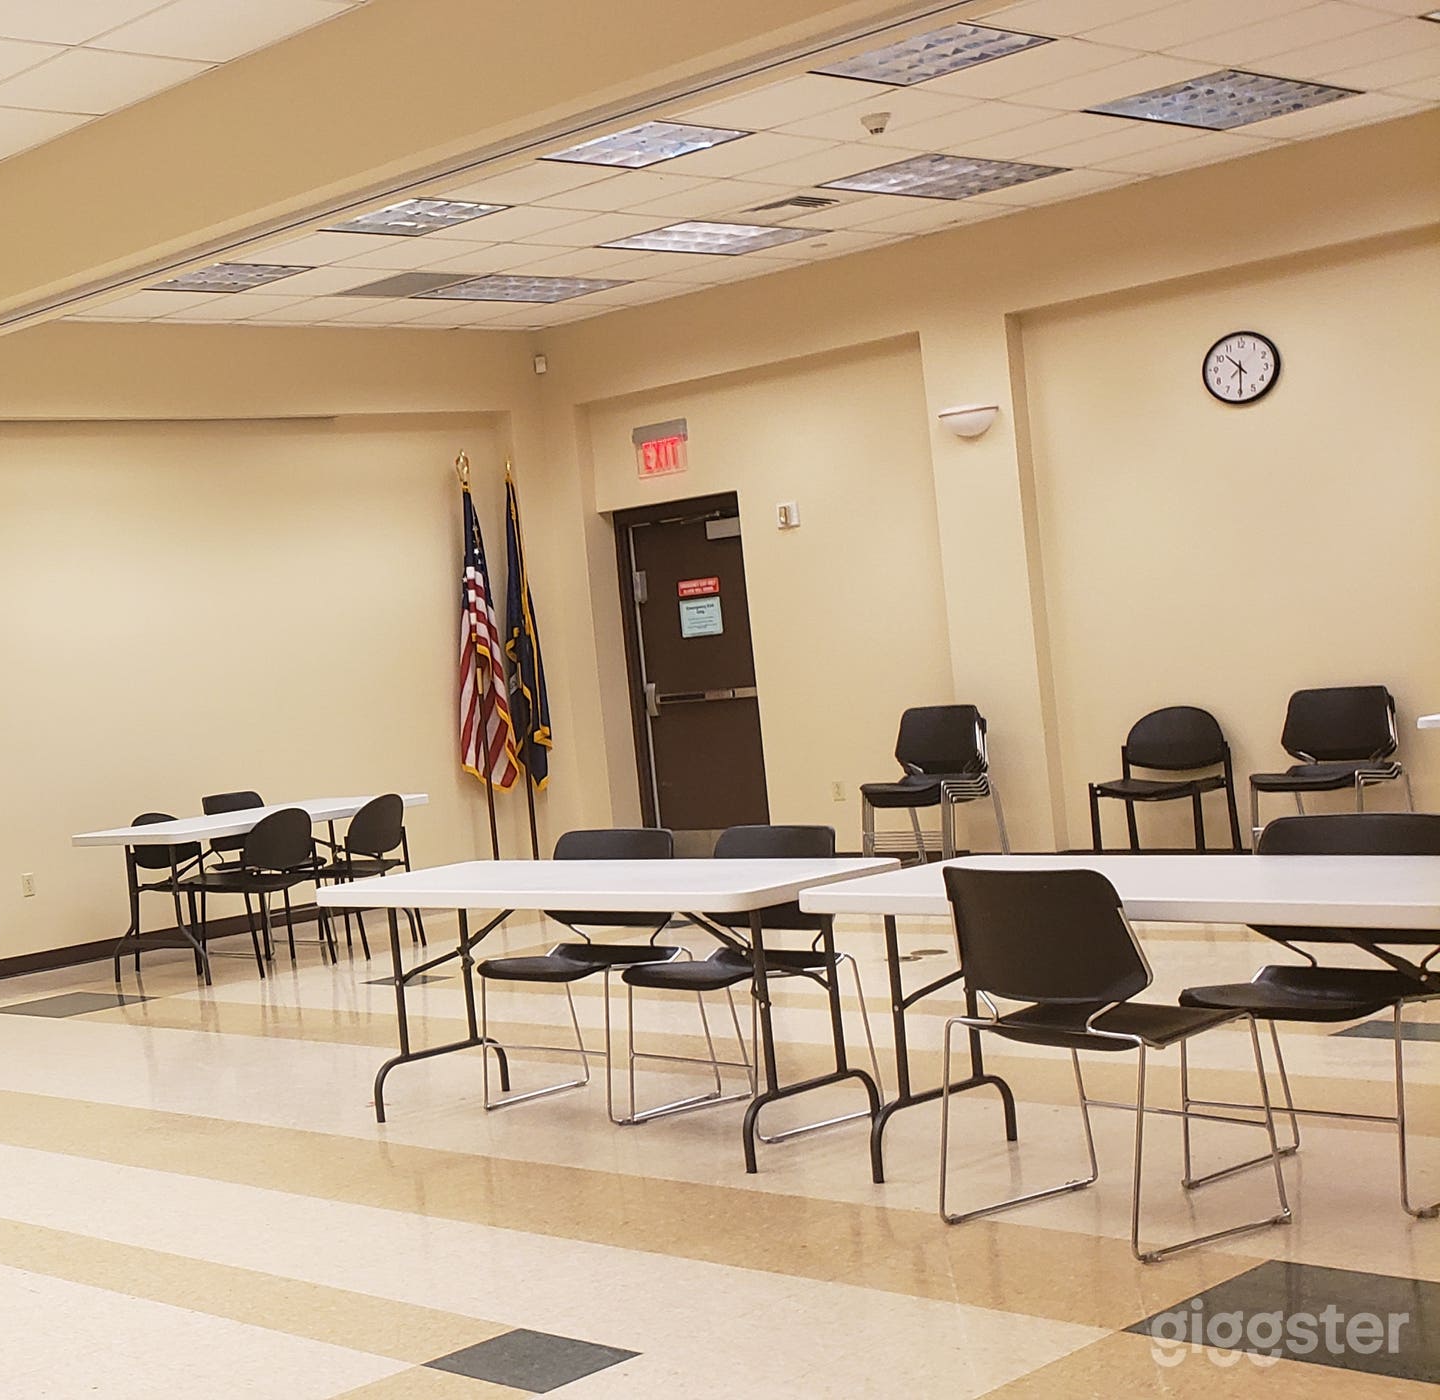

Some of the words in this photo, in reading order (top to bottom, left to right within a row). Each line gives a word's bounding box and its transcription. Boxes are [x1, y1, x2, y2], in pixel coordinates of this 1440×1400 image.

[1238, 339, 1245, 348] 12
[1261, 351, 1266, 359] 2
[1216, 377, 1221, 385] 8
[1251, 384, 1256, 392] 5
[642, 437, 680, 472] EXIT
